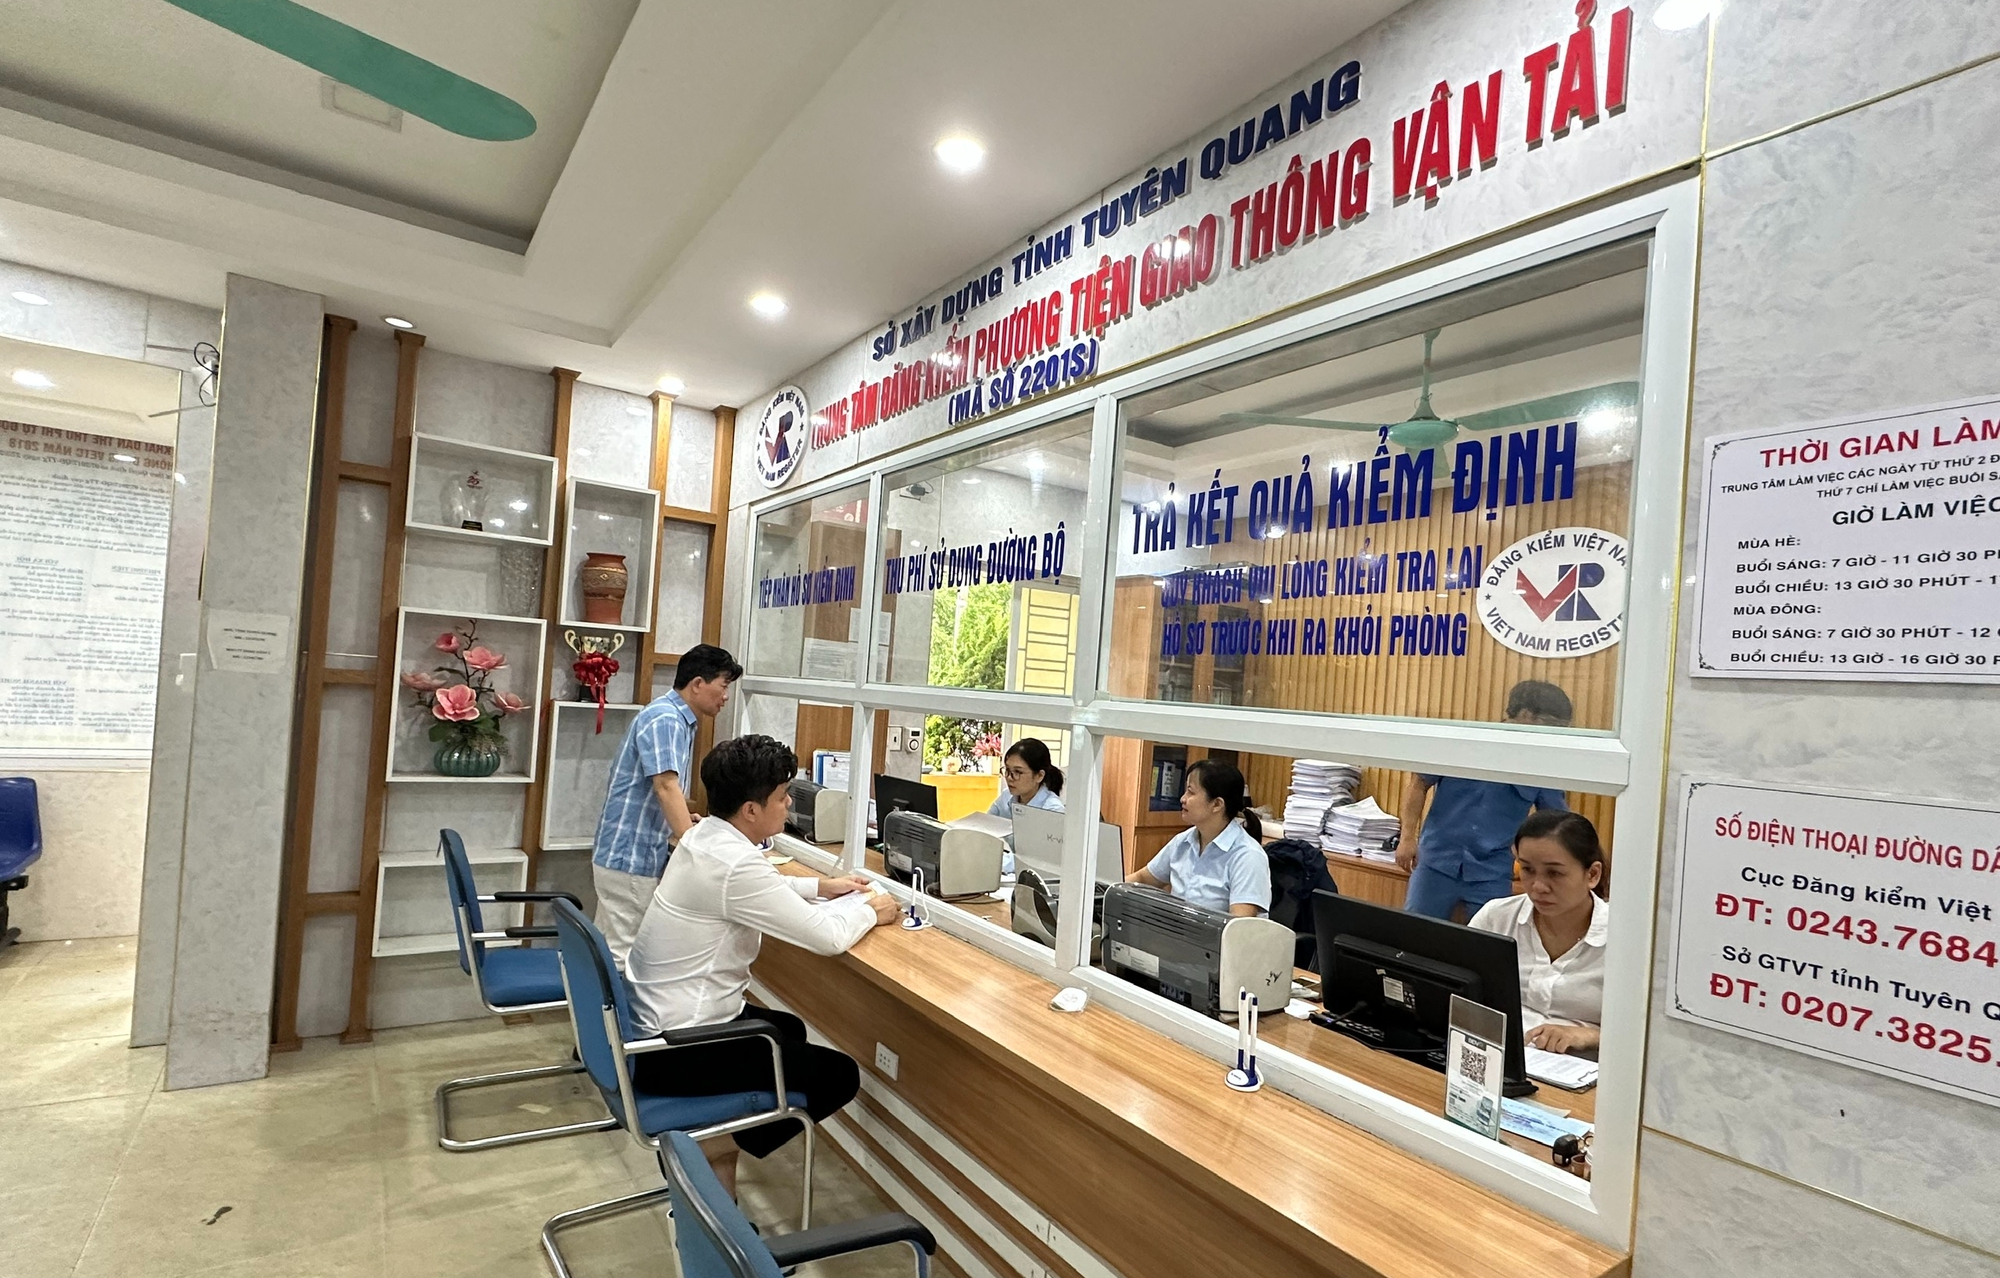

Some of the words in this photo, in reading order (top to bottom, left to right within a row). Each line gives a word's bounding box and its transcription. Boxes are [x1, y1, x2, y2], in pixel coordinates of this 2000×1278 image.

[811, 397, 848, 450] TRUNG
[851, 380, 880, 431] TÂM
[881, 361, 925, 421] ĐĂNG
[925, 325, 971, 400] KIỂM
[975, 298, 1063, 378] PHƯƠNG
[1070, 254, 1134, 339] TIỆN
[1139, 213, 1218, 306] GIAO
[1230, 137, 1373, 269] THÔNG
[1393, 70, 1503, 209] VẬN
[1523, 0, 1633, 150] TẢI
[872, 320, 897, 361] SỞ
[900, 304, 937, 347] XÂY
[941, 267, 1003, 323] DỰNG
[1012, 235, 1073, 285] TỈNH
[1081, 157, 1188, 247] TUYÊN
[1200, 60, 1361, 180] QUANG
[948, 376, 983, 425] (MÃ
[989, 362, 1019, 410] SỐ
[1019, 338, 1099, 398] 2201S)
[1760, 439, 1829, 468] THỜI
[1839, 429, 1919, 459] GIAN
[1933, 416, 2000, 447] LÀM
[1133, 487, 1177, 555] TRẢ
[1186, 468, 1239, 547] KẾT
[1248, 456, 1312, 541] QUẢ
[1327, 426, 1435, 529] KIỂM
[1452, 422, 1578, 521] ĐỊNH
[1721, 482, 1759, 494] TRUNG
[1761, 475, 1786, 490] TÂM
[1789, 474, 1814, 487] LÀM
[1816, 470, 1845, 484] VIỆC
[1848, 467, 1875, 479] CÁC
[1878, 463, 1916, 476] NGÀY
[1920, 459, 1940, 471] TỪ
[1943, 456, 1975, 468] THỨ
[1978, 456, 1986, 465] 2
[1816, 486, 1844, 498] THỨ
[1846, 486, 1853, 495] 7
[1856, 482, 1879, 495] CHỈ
[1881, 479, 1910, 492] LÀM
[1913, 477, 1945, 489] VIỆC
[1949, 471, 1985, 485] BUỔI
[1832, 505, 1874, 525] GIỜ
[1882, 501, 1934, 522] LÀM
[885, 557, 905, 595] THU
[906, 545, 928, 592] PHÍ
[929, 537, 946, 590] SỬ
[948, 545, 983, 593] DỤNG
[987, 528, 1037, 581] ĐƯỜNG
[1042, 521, 1066, 586] BỘ
[1486, 550, 1523, 587] ĐĂNG
[1526, 530, 1566, 555] KIỂM
[1573, 532, 1610, 552] VIỆT
[1608, 544, 1628, 570] NA
[1736, 558, 1772, 573] BUỔI
[1777, 558, 1827, 571] SÁNG:
[1831, 558, 1840, 569] 7
[1846, 554, 1876, 567] GIỜ
[1893, 554, 1911, 565] 11
[1917, 550, 1951, 563] GIỜ
[1956, 551, 1977, 561] 30
[1984, 549, 2000, 560] P
[1738, 537, 1770, 550] MÙA
[1775, 535, 1801, 548] HÈ:
[759, 569, 772, 609] TIẾP
[772, 572, 791, 614] NHẬN
[790, 564, 801, 606] HỒ
[802, 570, 813, 606] SƠ
[813, 555, 834, 604] KIỂM
[835, 566, 855, 608] ĐỊNH
[1192, 563, 1243, 605] KHÁCH
[1280, 554, 1328, 599] LÒNG
[1335, 538, 1388, 596] KIỂM
[1396, 551, 1438, 594] TRA
[1444, 545, 1483, 596] LẠI
[1735, 579, 1770, 594] BUỔI
[1777, 579, 1829, 592] CHIỀU:
[1835, 580, 1852, 591] 13
[1858, 576, 1889, 590] GIỜ
[1893, 578, 1913, 588] 30
[1919, 574, 1970, 587] PHÚT
[1989, 575, 2000, 585] 1
[1162, 612, 1181, 655] HỒ
[1186, 620, 1206, 655] SƠ
[1211, 613, 1262, 655] TRƯỚC
[1266, 619, 1297, 655] KHI
[1302, 618, 1326, 655] RA
[1333, 604, 1383, 656] KHỎI
[1388, 606, 1467, 656] PHÒNG
[1486, 607, 1515, 639] VIET
[1515, 632, 1551, 651] NAM
[1732, 625, 1767, 640] BUỔI
[1772, 625, 1822, 639] SÁNG:
[1827, 629, 1836, 639] 7
[1841, 626, 1872, 639] GIỜ
[1876, 628, 1896, 639] 30
[1901, 625, 1951, 638] PHÚT
[1970, 628, 1990, 638] 12
[1733, 604, 1766, 616] MÙA
[1770, 602, 1822, 615] ĐÔNG:
[1730, 649, 1766, 663] BUỔI
[1770, 649, 1824, 664] CHIỀU:
[1829, 654, 1847, 664] 13
[1853, 652, 1884, 665] GIỜ
[1900, 654, 1919, 665] 16
[1925, 652, 1959, 665] GIỜ
[1964, 655, 1986, 665] 30
[1715, 811, 1743, 839] SỐ
[1747, 818, 1795, 847] ĐIỆN
[1802, 827, 1868, 859] THOẠI
[1875, 835, 1962, 869] ĐƯỜNG
[1741, 866, 1784, 888] Cục
[1792, 874, 1855, 902] Đăng
[1865, 886, 1926, 910] kiểm
[1937, 897, 1992, 922] Việt
[1715, 893, 1772, 925] ĐT:
[1787, 906, 1999, 968] 0243.7684
[1710, 973, 1767, 1008] ĐT:
[1722, 945, 1751, 965] Sở
[1758, 953, 1824, 981] GTVT
[1831, 968, 1879, 994] tỉnh
[1889, 980, 1971, 1014] Tuyên
